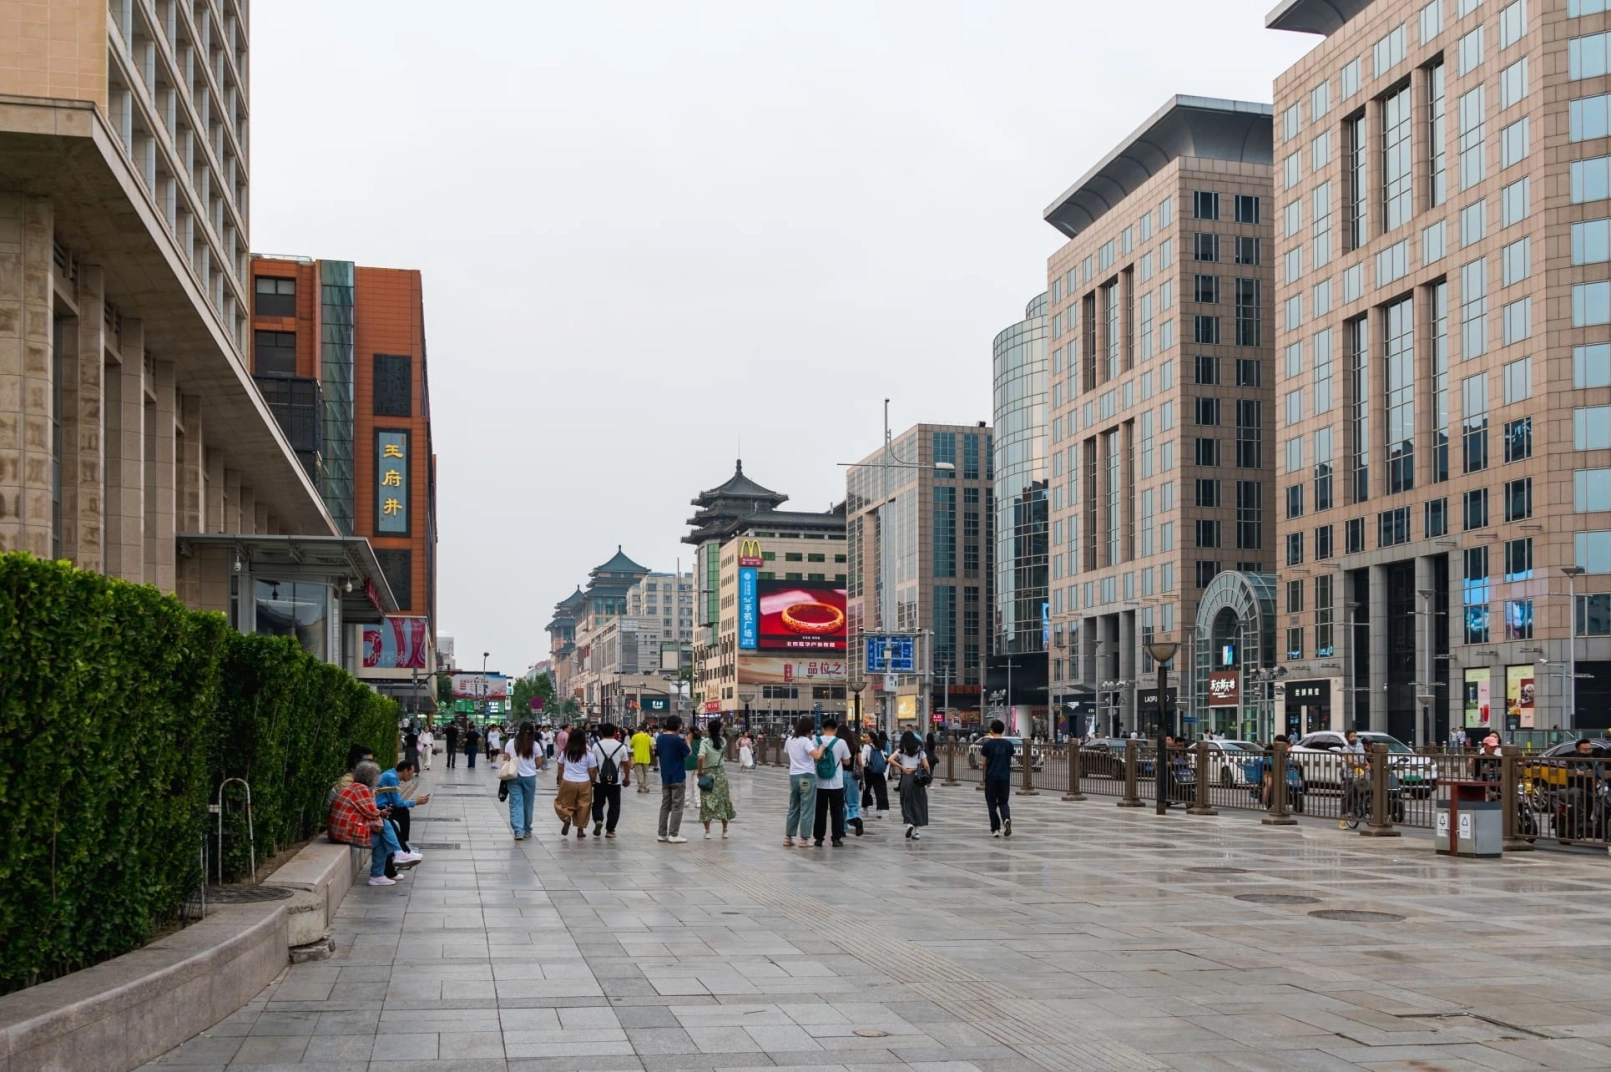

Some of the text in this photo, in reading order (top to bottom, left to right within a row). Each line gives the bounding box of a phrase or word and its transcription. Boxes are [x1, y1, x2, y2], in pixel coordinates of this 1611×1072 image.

[382, 444, 403, 515] 王府井
[1210, 679, 1236, 692] 东方新天地
